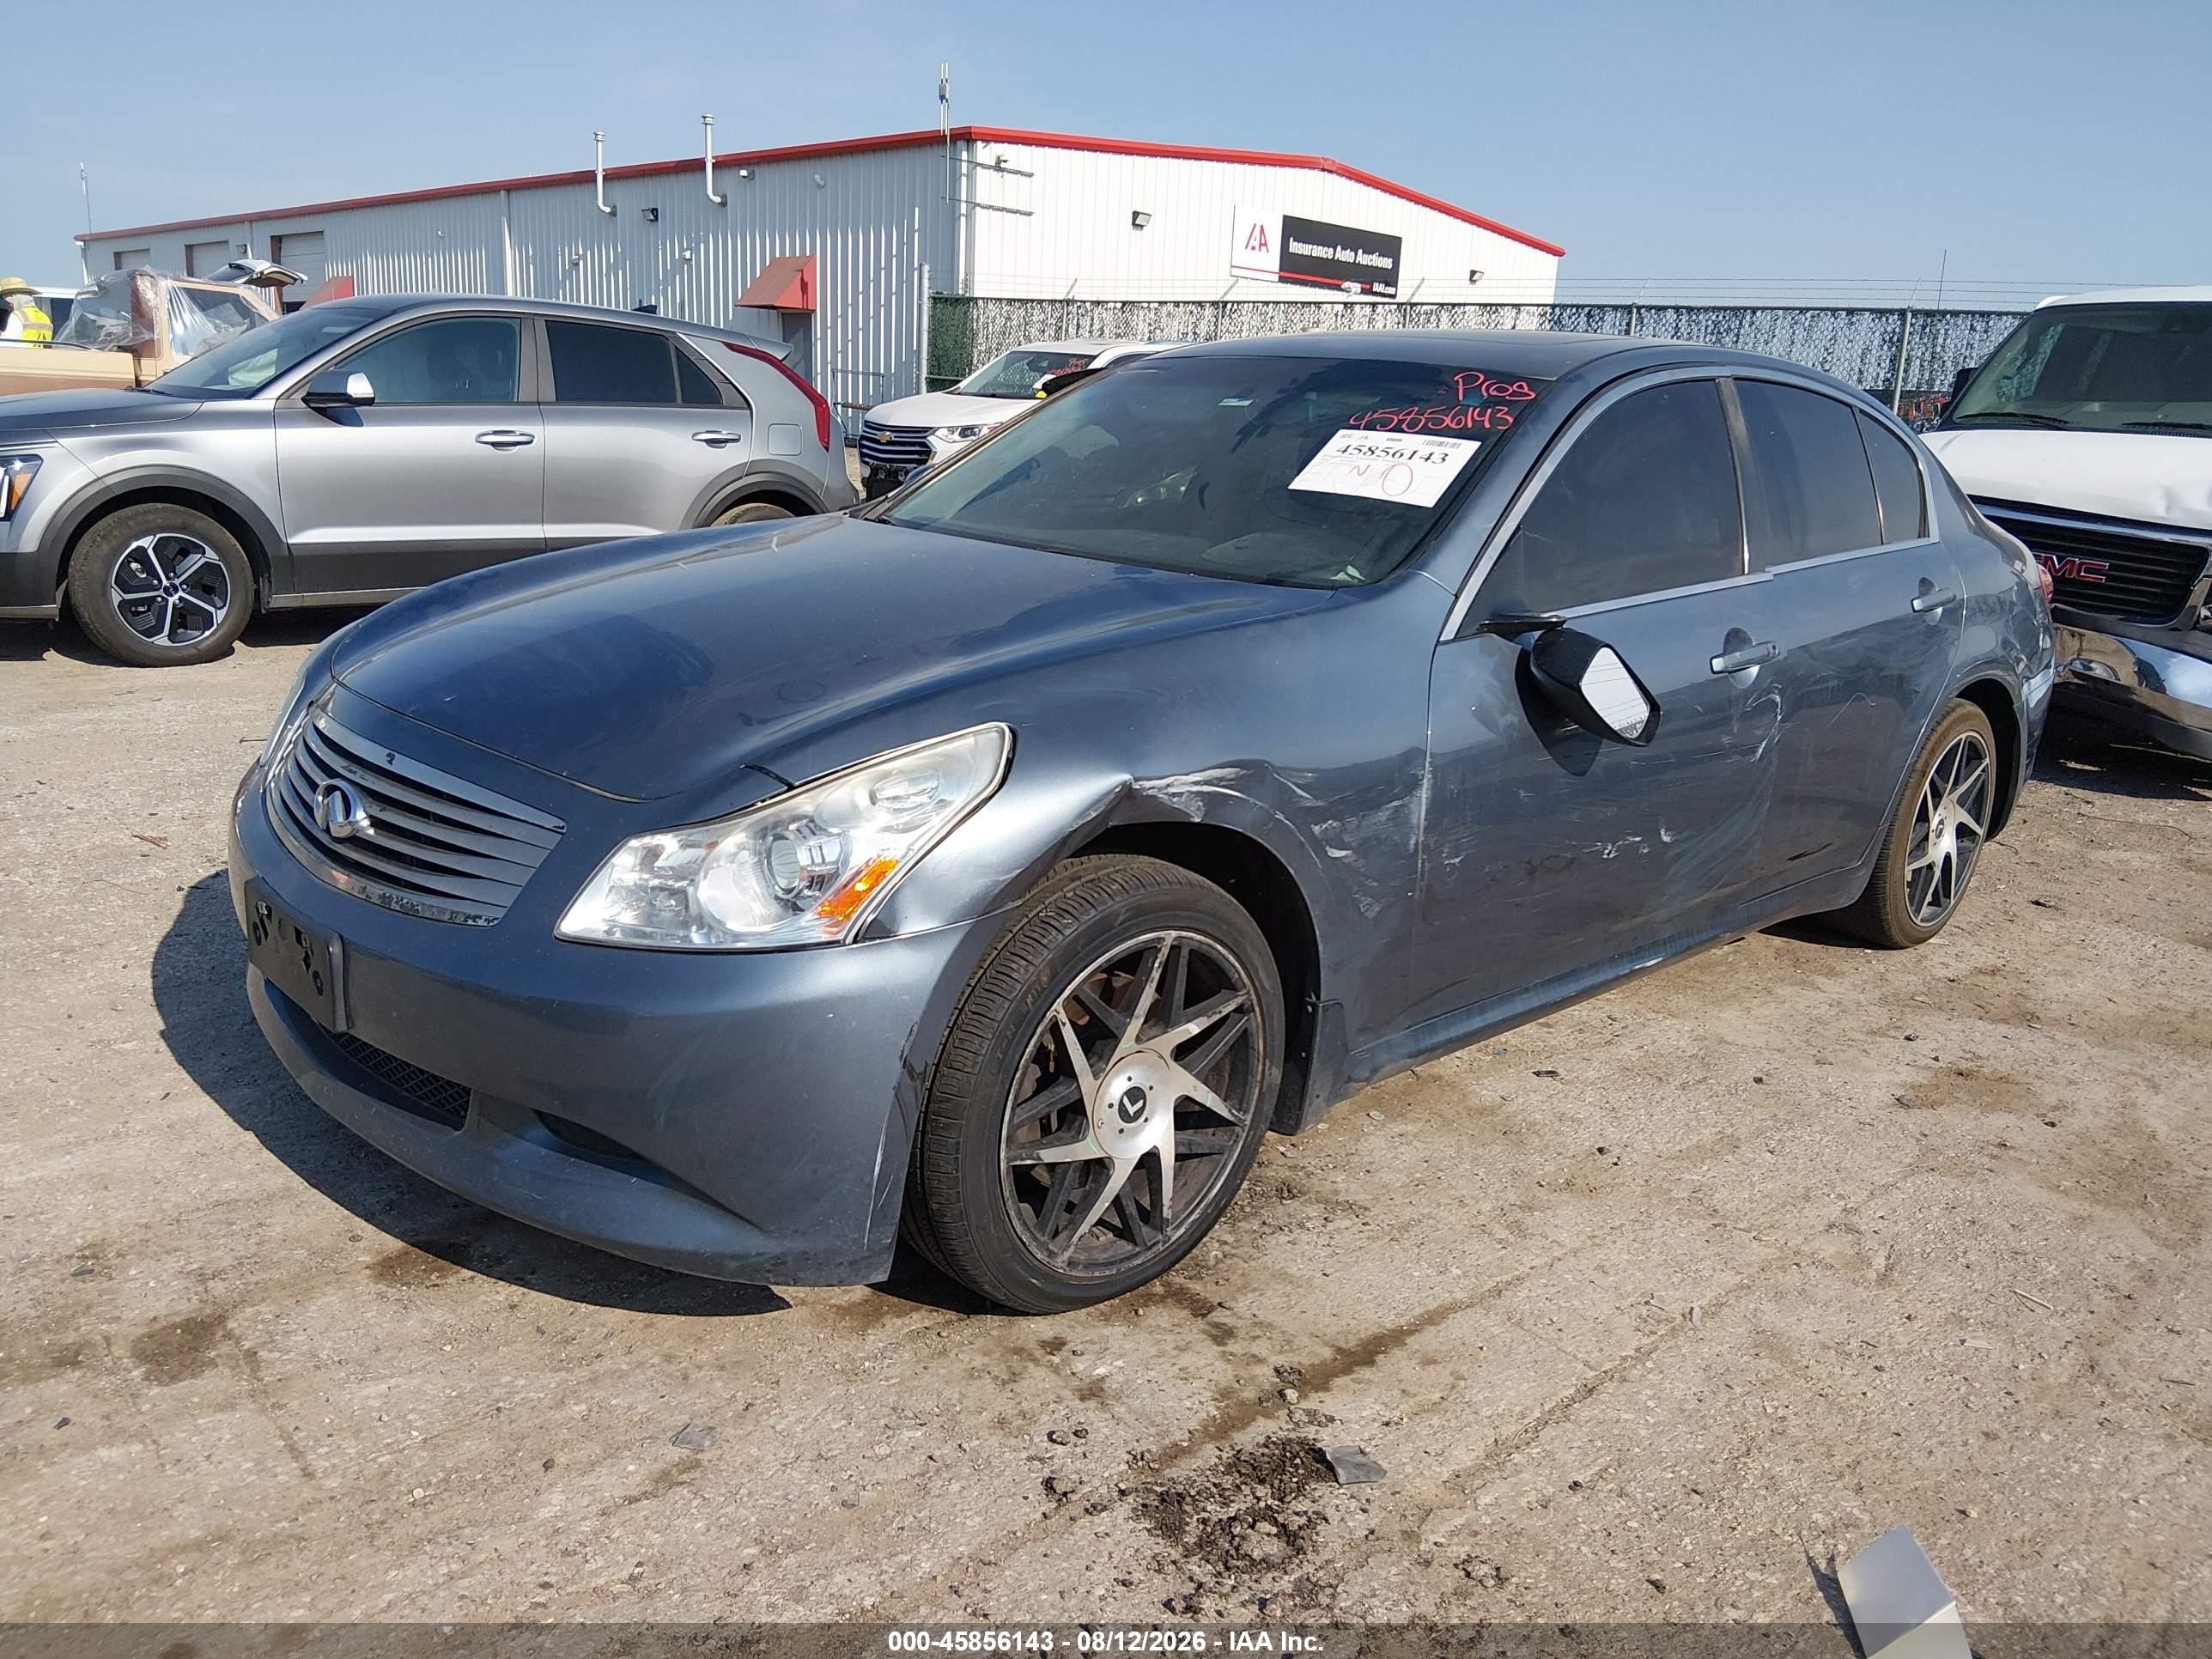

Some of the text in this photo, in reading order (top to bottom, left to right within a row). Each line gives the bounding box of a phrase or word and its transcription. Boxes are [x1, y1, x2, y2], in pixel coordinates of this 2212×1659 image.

[1289, 237, 1394, 270] Insurance Auto Auctions
[1349, 406, 1514, 433] 45856143
[1335, 444, 1449, 465] 45856143
[2033, 552, 2110, 584] MC
